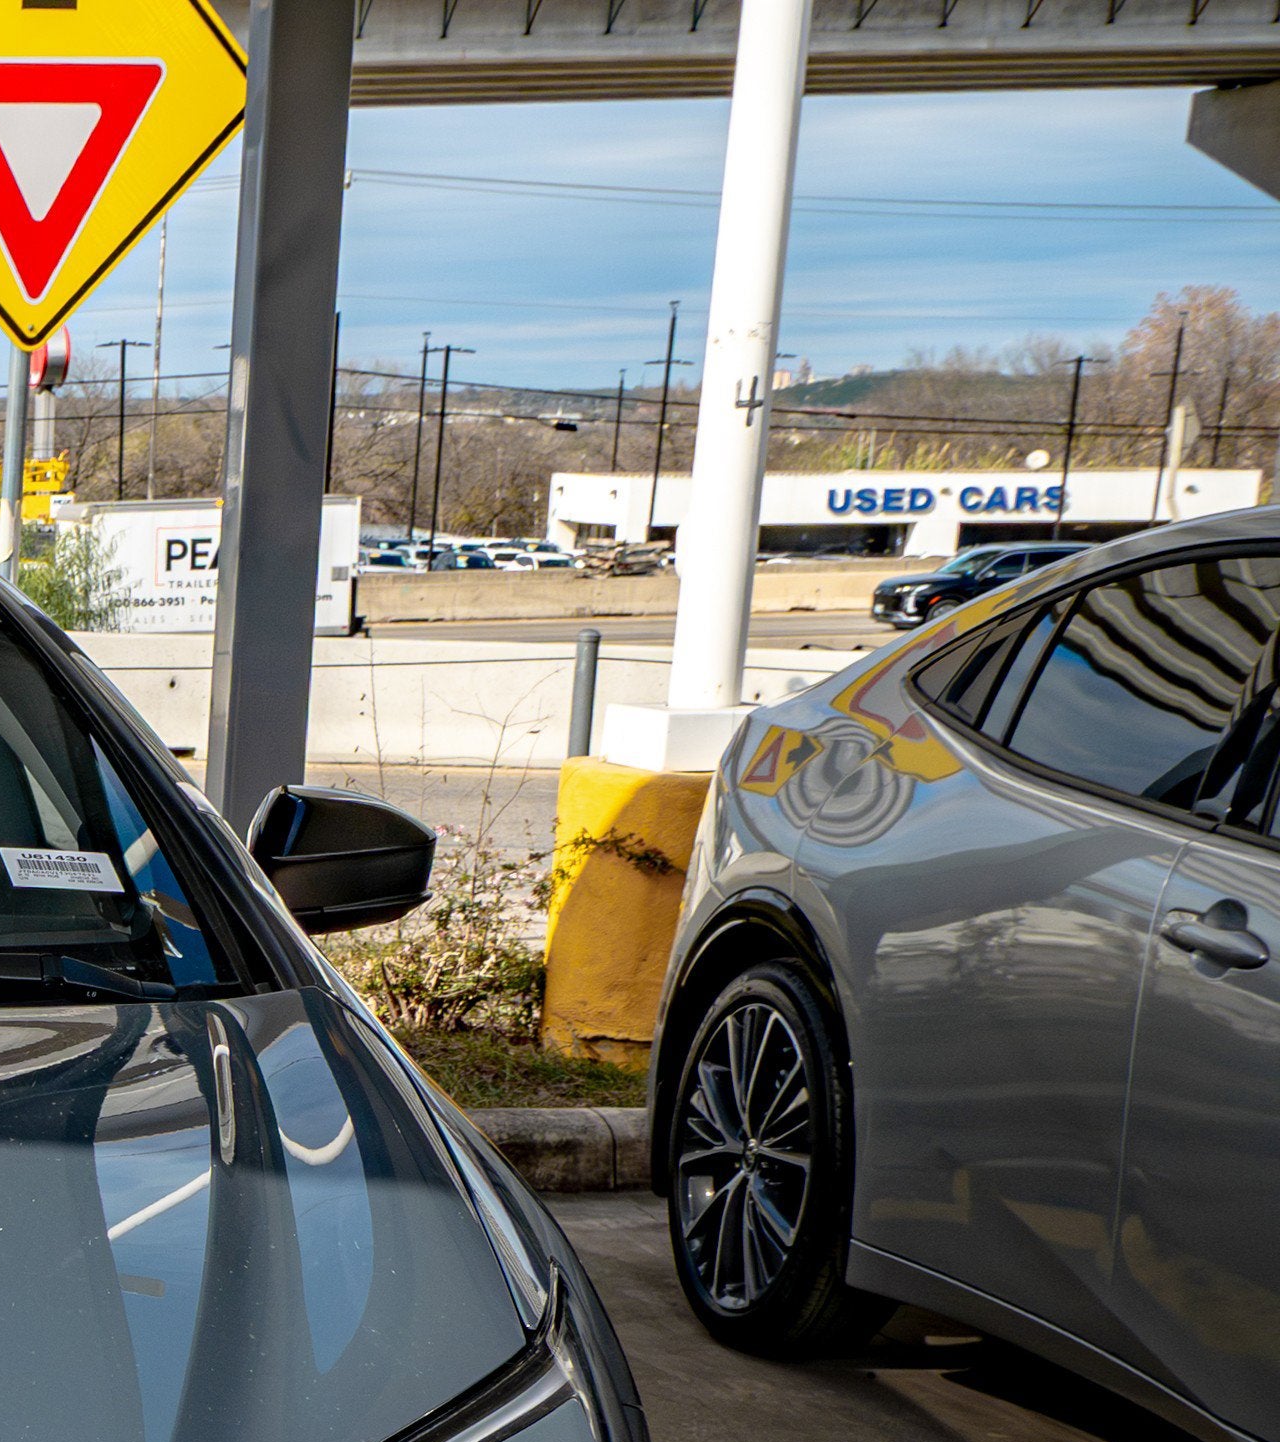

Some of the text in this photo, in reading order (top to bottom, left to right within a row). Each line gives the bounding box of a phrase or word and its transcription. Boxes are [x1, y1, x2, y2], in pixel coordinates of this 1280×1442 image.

[828, 486, 1067, 514] USED CARS
[110, 596, 186, 609] 00-866-3951
[21, 852, 88, 863] U61430
